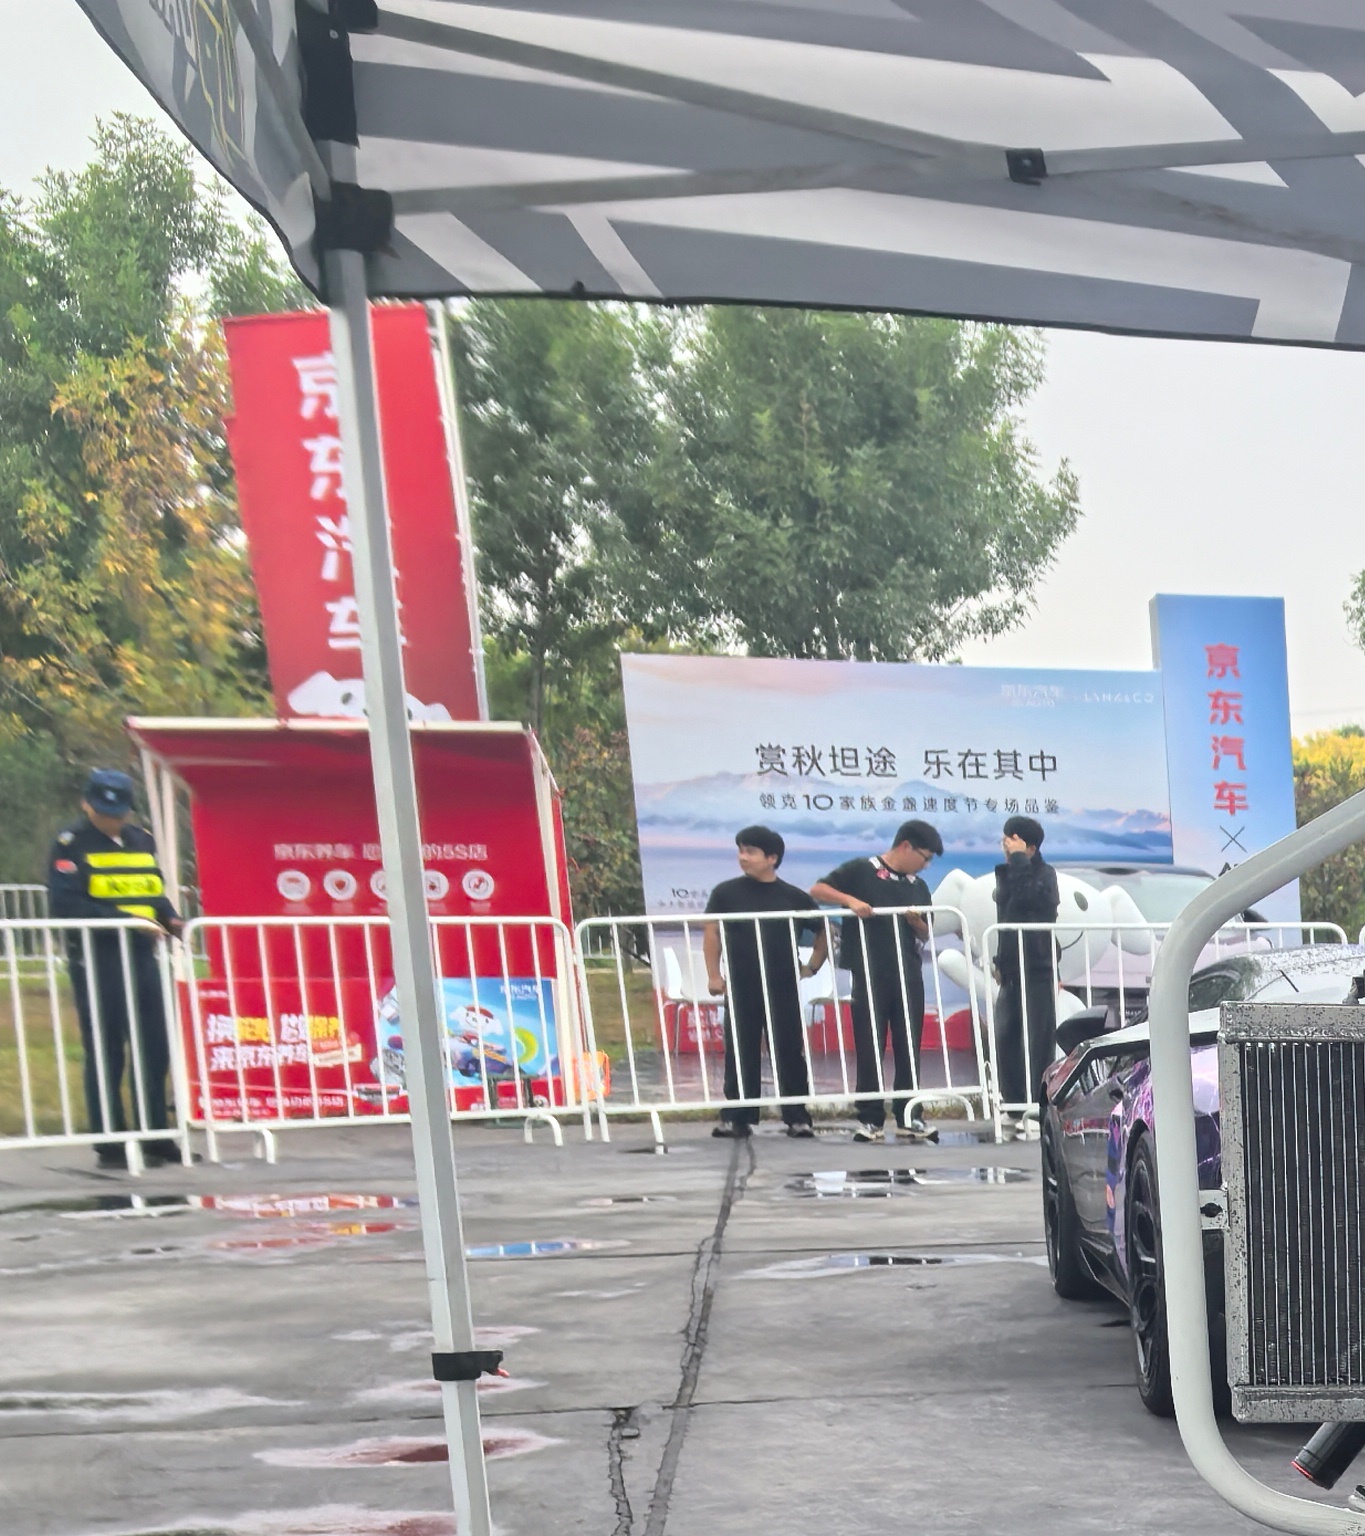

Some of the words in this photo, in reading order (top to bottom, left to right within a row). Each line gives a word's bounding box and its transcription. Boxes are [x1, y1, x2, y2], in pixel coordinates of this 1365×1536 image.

[755, 743, 898, 778] 赏秋坦途
[922, 748, 1059, 782] 乐在其中
[1204, 642, 1250, 816] 京东汽车
